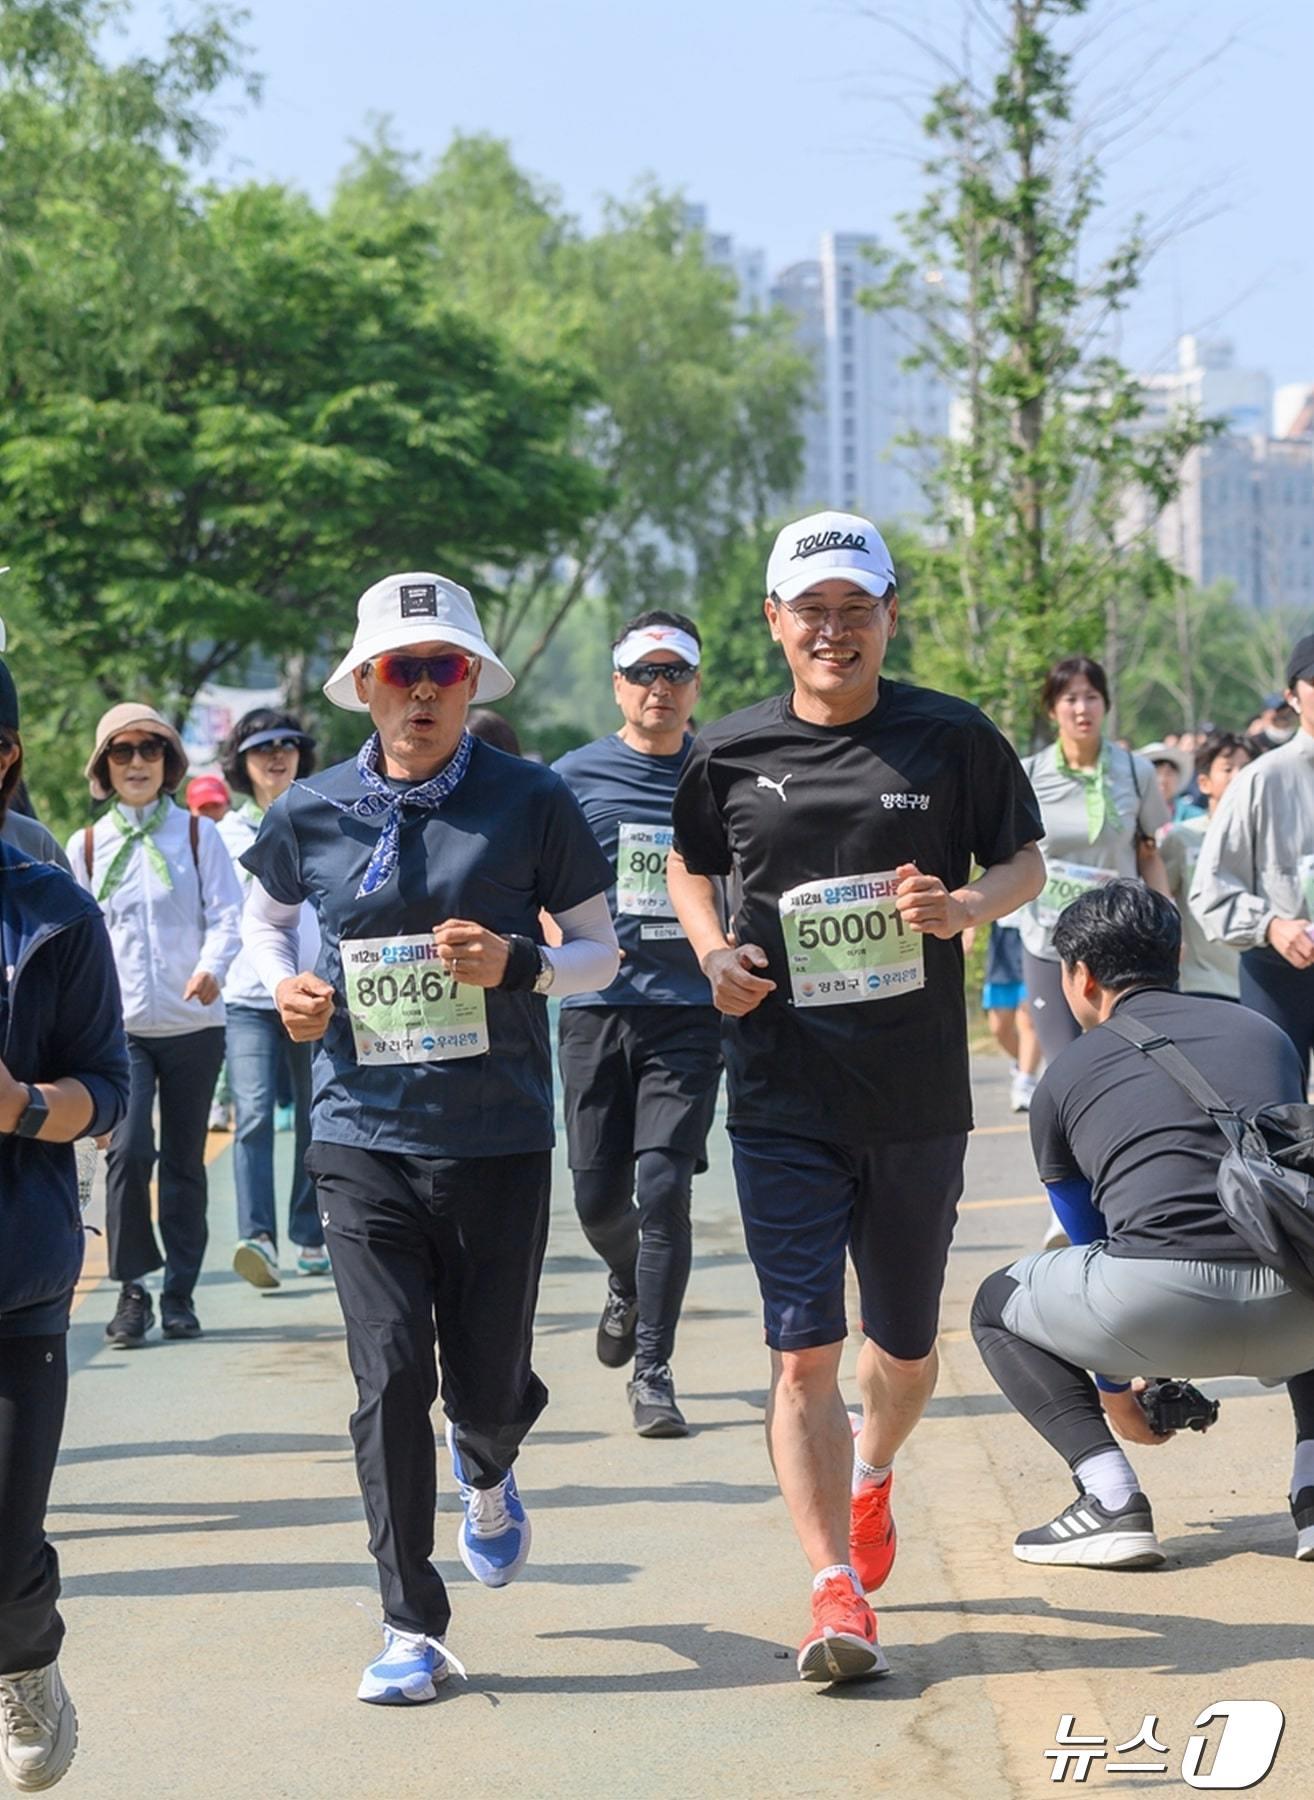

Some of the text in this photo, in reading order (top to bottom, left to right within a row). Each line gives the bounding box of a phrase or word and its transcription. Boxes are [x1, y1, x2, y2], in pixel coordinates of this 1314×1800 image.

[795, 531, 867, 556] TOURAD
[880, 793, 930, 811] 양천구청
[791, 892, 822, 906] 제12회
[798, 907, 905, 949] 50001
[356, 971, 459, 1008] 80467
[818, 978, 860, 994] 양천구
[437, 1032, 479, 1049] 우리은행
